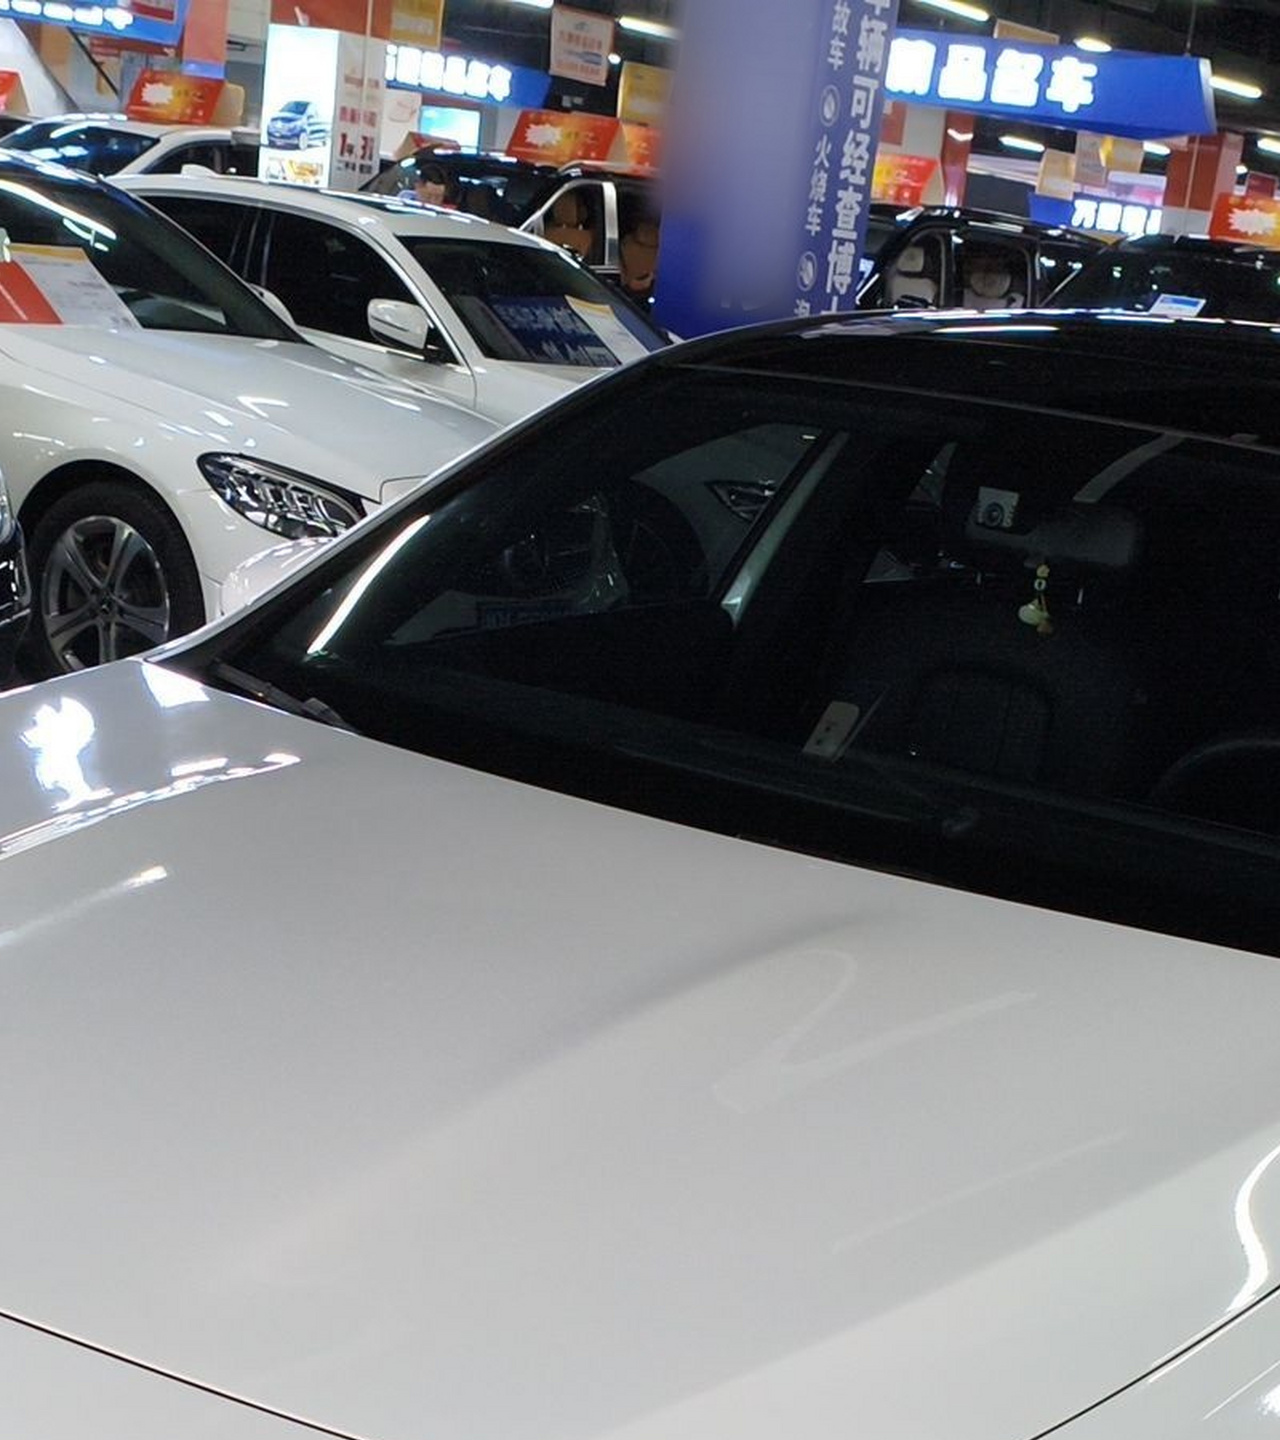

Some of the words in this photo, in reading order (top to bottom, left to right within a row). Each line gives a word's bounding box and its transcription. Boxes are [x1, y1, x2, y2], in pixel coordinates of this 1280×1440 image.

[821, 0, 890, 312] 辆可经查博
